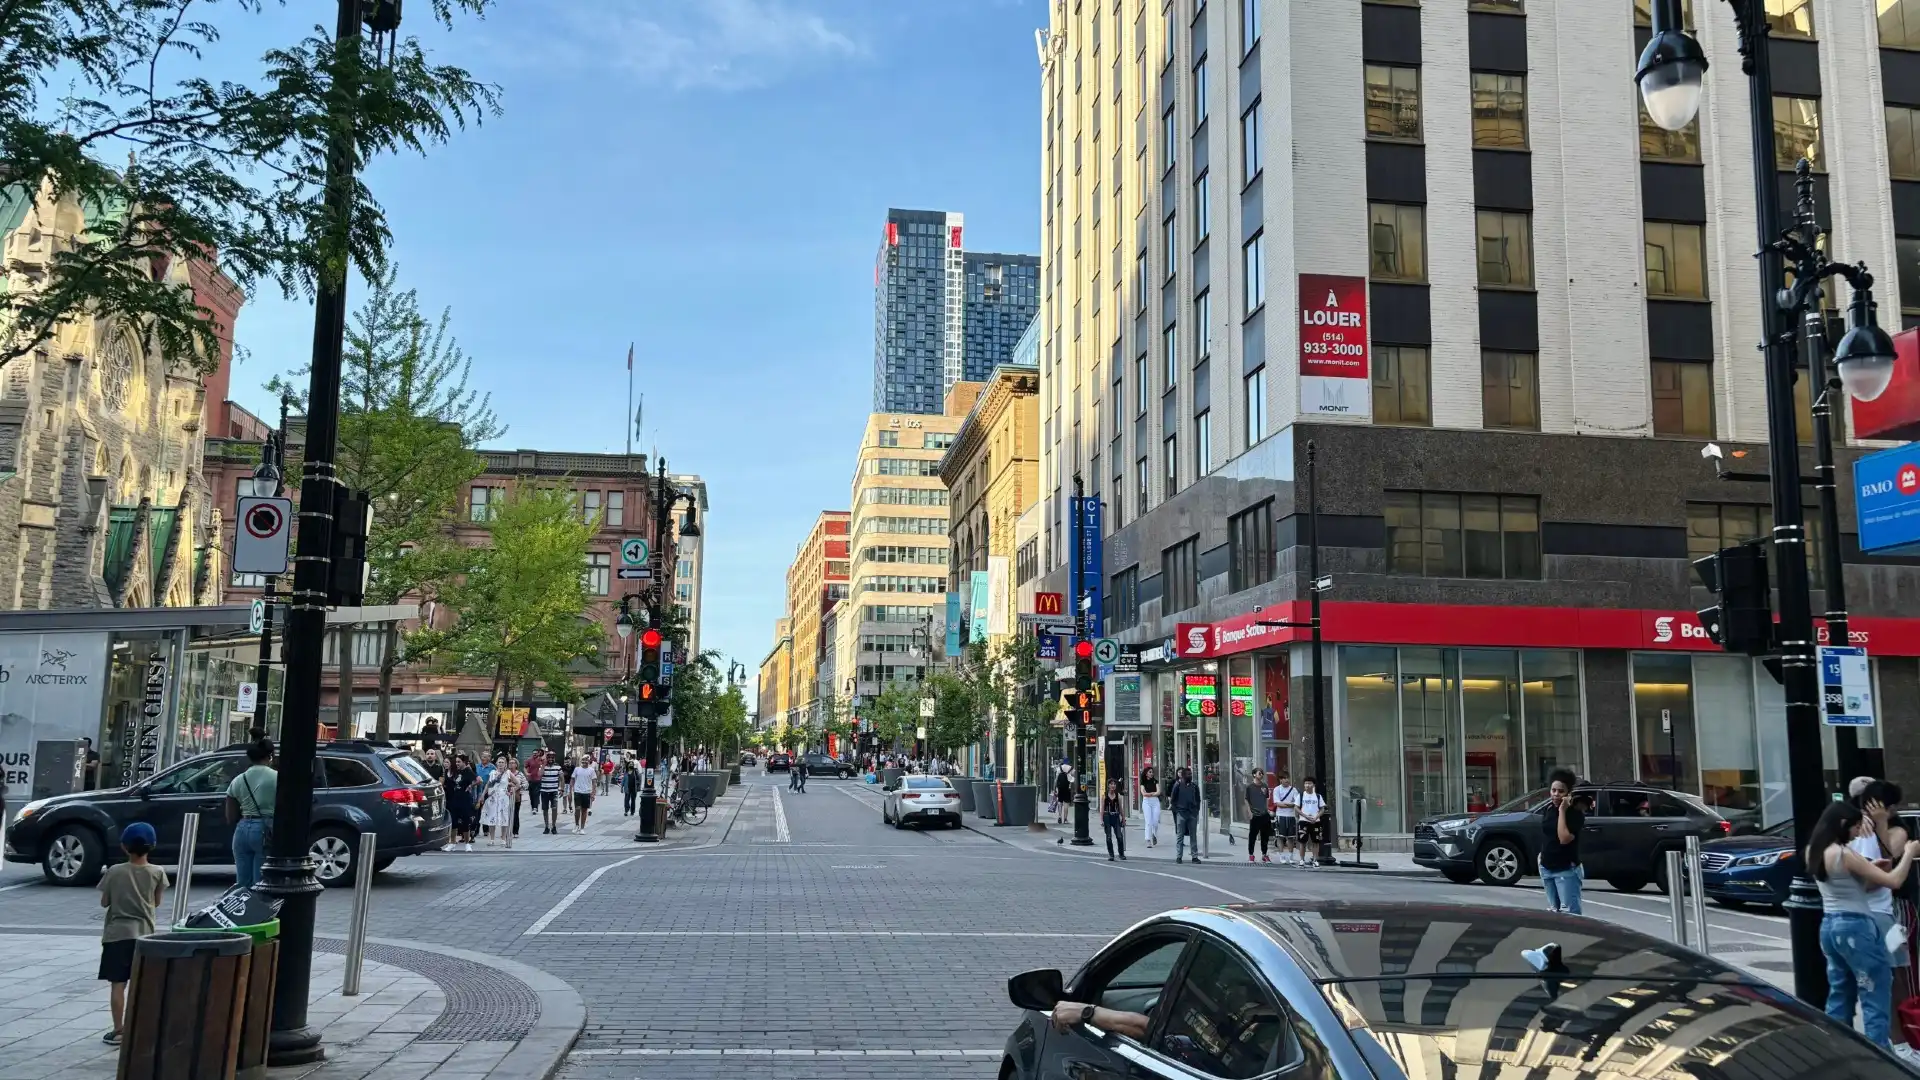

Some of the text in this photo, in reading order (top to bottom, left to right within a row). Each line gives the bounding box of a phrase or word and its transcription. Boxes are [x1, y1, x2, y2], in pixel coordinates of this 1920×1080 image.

[1326, 289, 1338, 307] À
[1303, 310, 1361, 327] LOUER
[1322, 332, 1344, 342] (514)
[1303, 342, 1363, 356] 933-3000
[1307, 358, 1360, 367] www.monit.com
[1861, 480, 1893, 497] BMO
[1222, 628, 1245, 644] Banque
[1828, 664, 1841, 673] 15
[144, 652, 168, 718] CHEST
[1824, 693, 1843, 703] 358
[122, 720, 137, 787] BOUTIQUE
